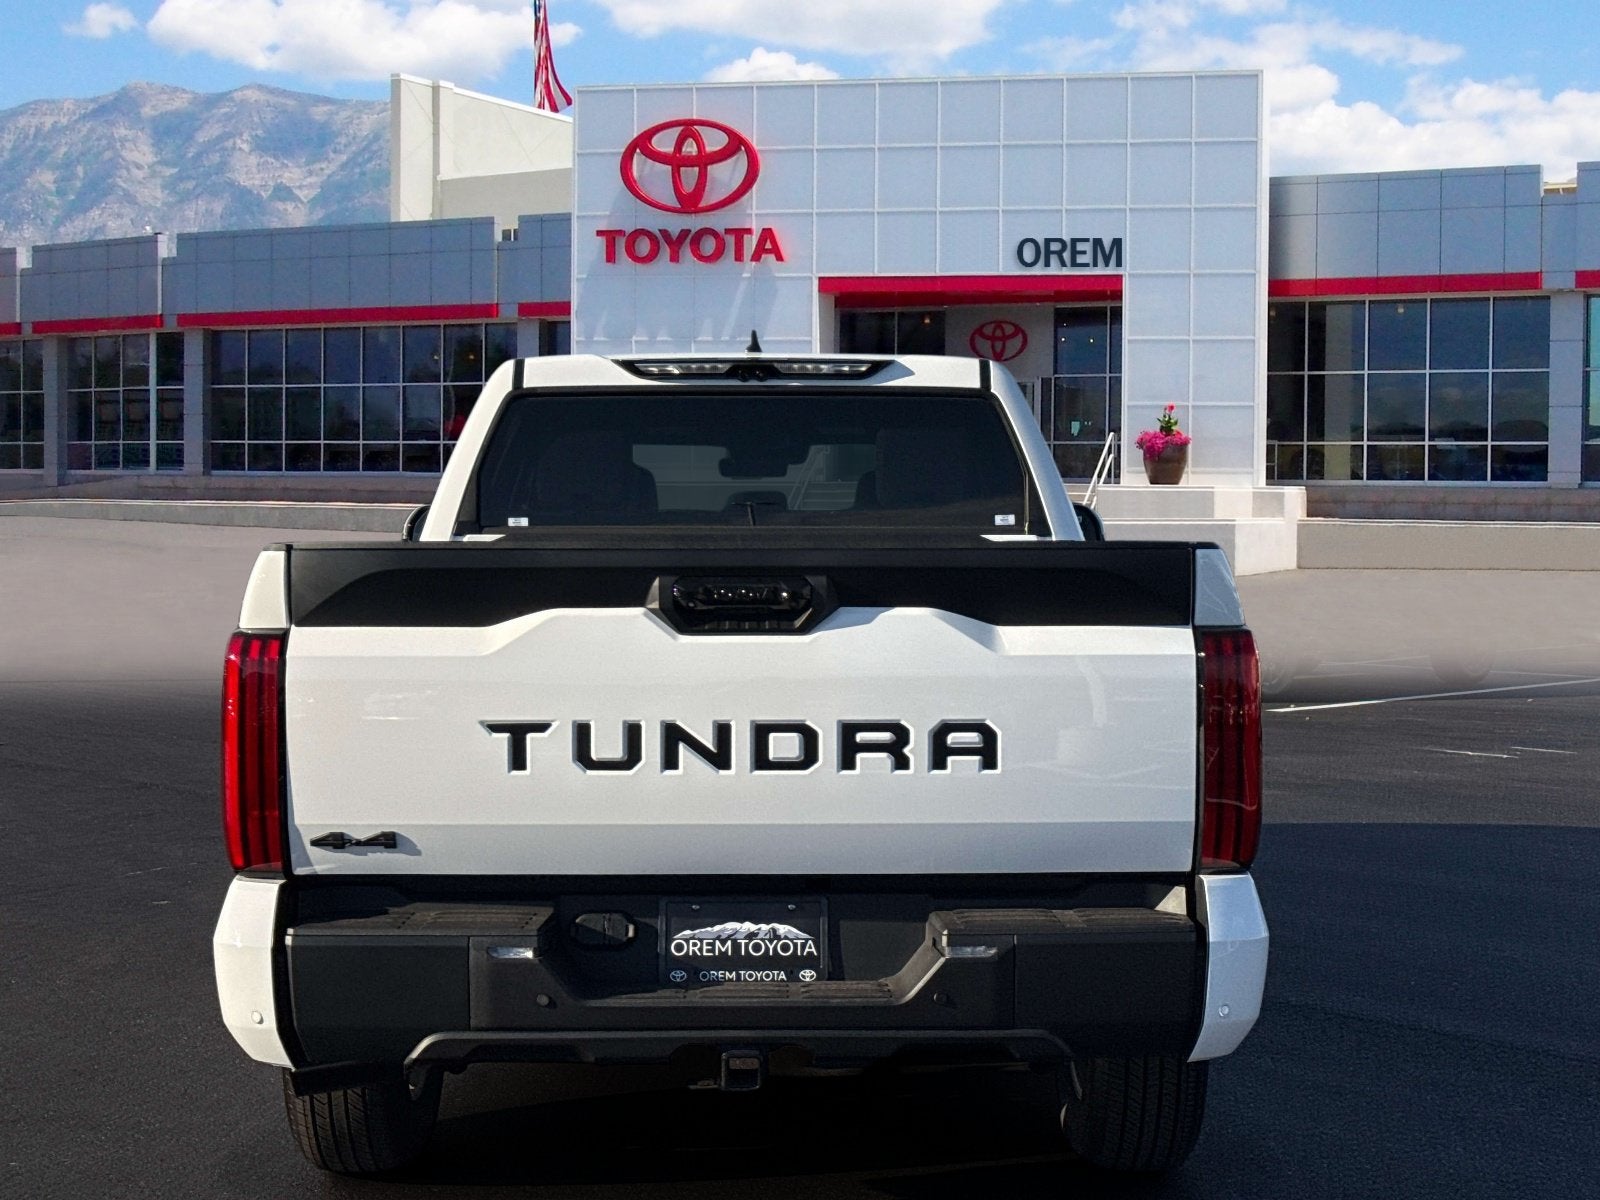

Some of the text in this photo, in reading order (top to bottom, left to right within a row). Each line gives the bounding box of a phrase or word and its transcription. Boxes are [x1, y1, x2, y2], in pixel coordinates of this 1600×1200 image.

[596, 227, 785, 264] TOYOTA
[1017, 237, 1123, 268] OREM
[478, 719, 1002, 775] TUNDRA
[670, 939, 818, 957] OREM TOYOTA
[699, 970, 787, 982] OREM TOYOTA
